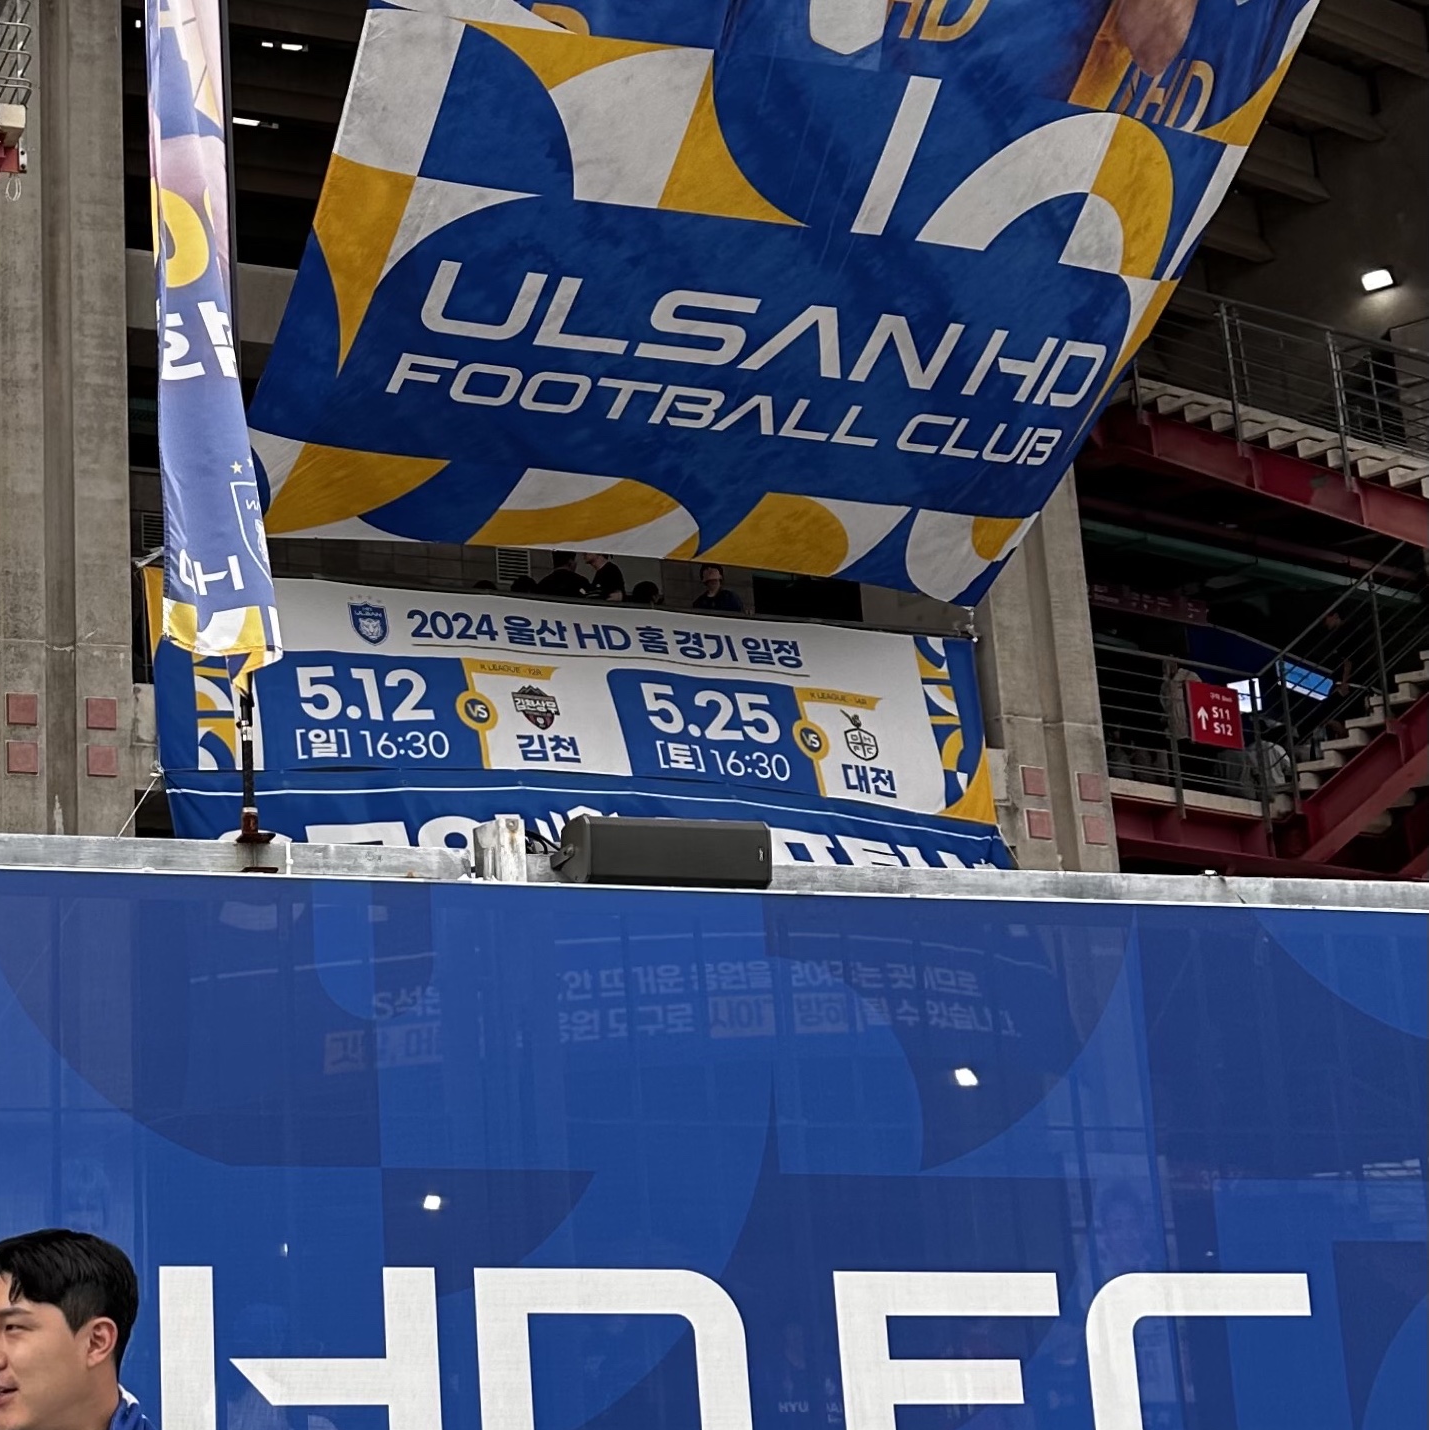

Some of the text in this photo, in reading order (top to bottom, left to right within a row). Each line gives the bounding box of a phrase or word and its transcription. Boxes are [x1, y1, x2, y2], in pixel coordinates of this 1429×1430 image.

[421, 259, 1108, 408] ULSAN HD
[384, 352, 1062, 467] FOOTBALL CLUB
[407, 609, 803, 669] 2024 울산 HD 홈 경기 일정
[296, 665, 435, 721] 5.12
[467, 702, 488, 719] VS
[640, 682, 781, 744] 5.25
[1212, 706, 1231, 720] S11
[1213, 722, 1233, 736] S12
[296, 729, 450, 759] [일] 16:30
[516, 734, 582, 763] 김천
[802, 733, 820, 749] VS
[655, 740, 791, 782] [토] 16:30
[842, 764, 897, 799] 대전
